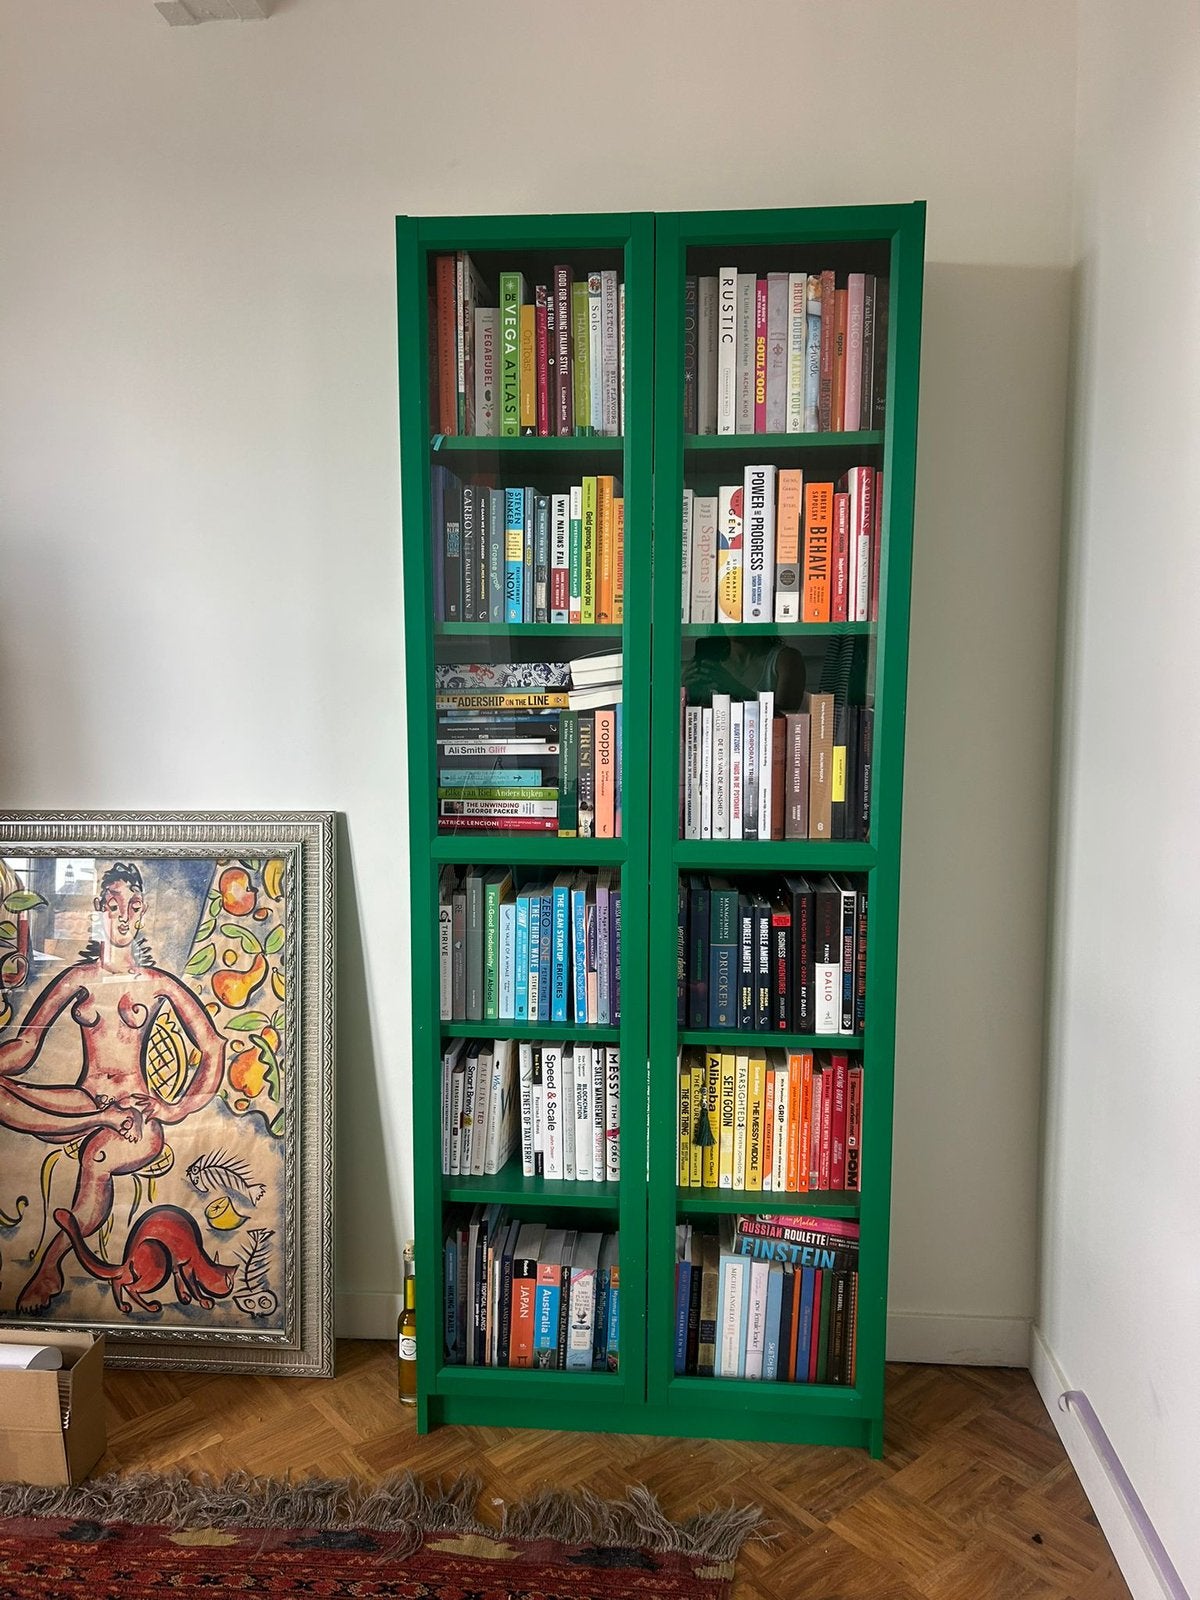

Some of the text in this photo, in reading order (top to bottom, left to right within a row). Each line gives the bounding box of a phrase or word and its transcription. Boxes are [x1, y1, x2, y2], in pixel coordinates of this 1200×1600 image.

[505, 293, 516, 302] DE
[591, 305, 599, 331] Solo
[722, 278, 733, 343] RUSTIC
[505, 304, 516, 354] VEGA
[558, 270, 568, 375] FOOD FOR SHARING ITALIAN STYLE
[836, 332, 844, 357] tapas
[851, 304, 861, 348] MEXICO
[756, 336, 765, 403] SOUL FOOD
[792, 283, 803, 415] BRUNO LOUBET MANGE TOUT
[505, 360, 516, 413] ATLAS
[463, 489, 472, 538] CARBON
[556, 520, 564, 548] NATIONS
[728, 508, 736, 542] GENE
[751, 472, 765, 570] POWER PROGRESS
[556, 551, 564, 565] FAIL
[697, 526, 714, 583] Sapiens
[808, 526, 827, 581] BEHAVE
[505, 698, 514, 706] ON
[515, 698, 527, 706] THE
[528, 695, 549, 706] LINE
[460, 746, 486, 754] Smith
[580, 724, 591, 769] TRUST
[598, 720, 610, 765] oroppa
[717, 738, 723, 746] DE
[717, 776, 723, 784] DE
[531, 904, 539, 967] THE THIRD WAVE
[541, 898, 551, 961] ZERO ONE
[556, 930, 564, 961] STARTUP
[743, 917, 751, 973] MORELE AMBITIE
[760, 918, 768, 974] MORELE AMBITIE
[718, 951, 728, 1007] DRUCKER
[778, 931, 786, 995] BUSINESS ADVENTURES
[464, 1066, 475, 1117] Smart Brevity
[480, 1062, 488, 1084] TALK
[545, 1054, 557, 1089] Speed
[609, 1053, 619, 1099] MESSY
[709, 1057, 719, 1112] Alibaba
[478, 1087, 487, 1107] LIKE
[547, 1102, 557, 1131] Scale
[594, 1066, 603, 1128] SALES MANAGEMENT
[723, 1075, 733, 1127] SETH GODIN
[738, 1068, 746, 1122] FARSIGHTED
[524, 1117, 530, 1125] OF
[681, 1116, 689, 1136] THING
[751, 1142, 759, 1171] MIDDLE
[848, 1149, 858, 1187] POM
[741, 1236, 836, 1269] EINSTEIN
[742, 1221, 826, 1246] RUSSIAN ROULETTE
[519, 1285, 529, 1318] JAPAN
[541, 1289, 551, 1333] Australia
[597, 1291, 606, 1329] Philippines
[729, 1268, 737, 1322] MICHELANGELO
[753, 1312, 761, 1331] female
